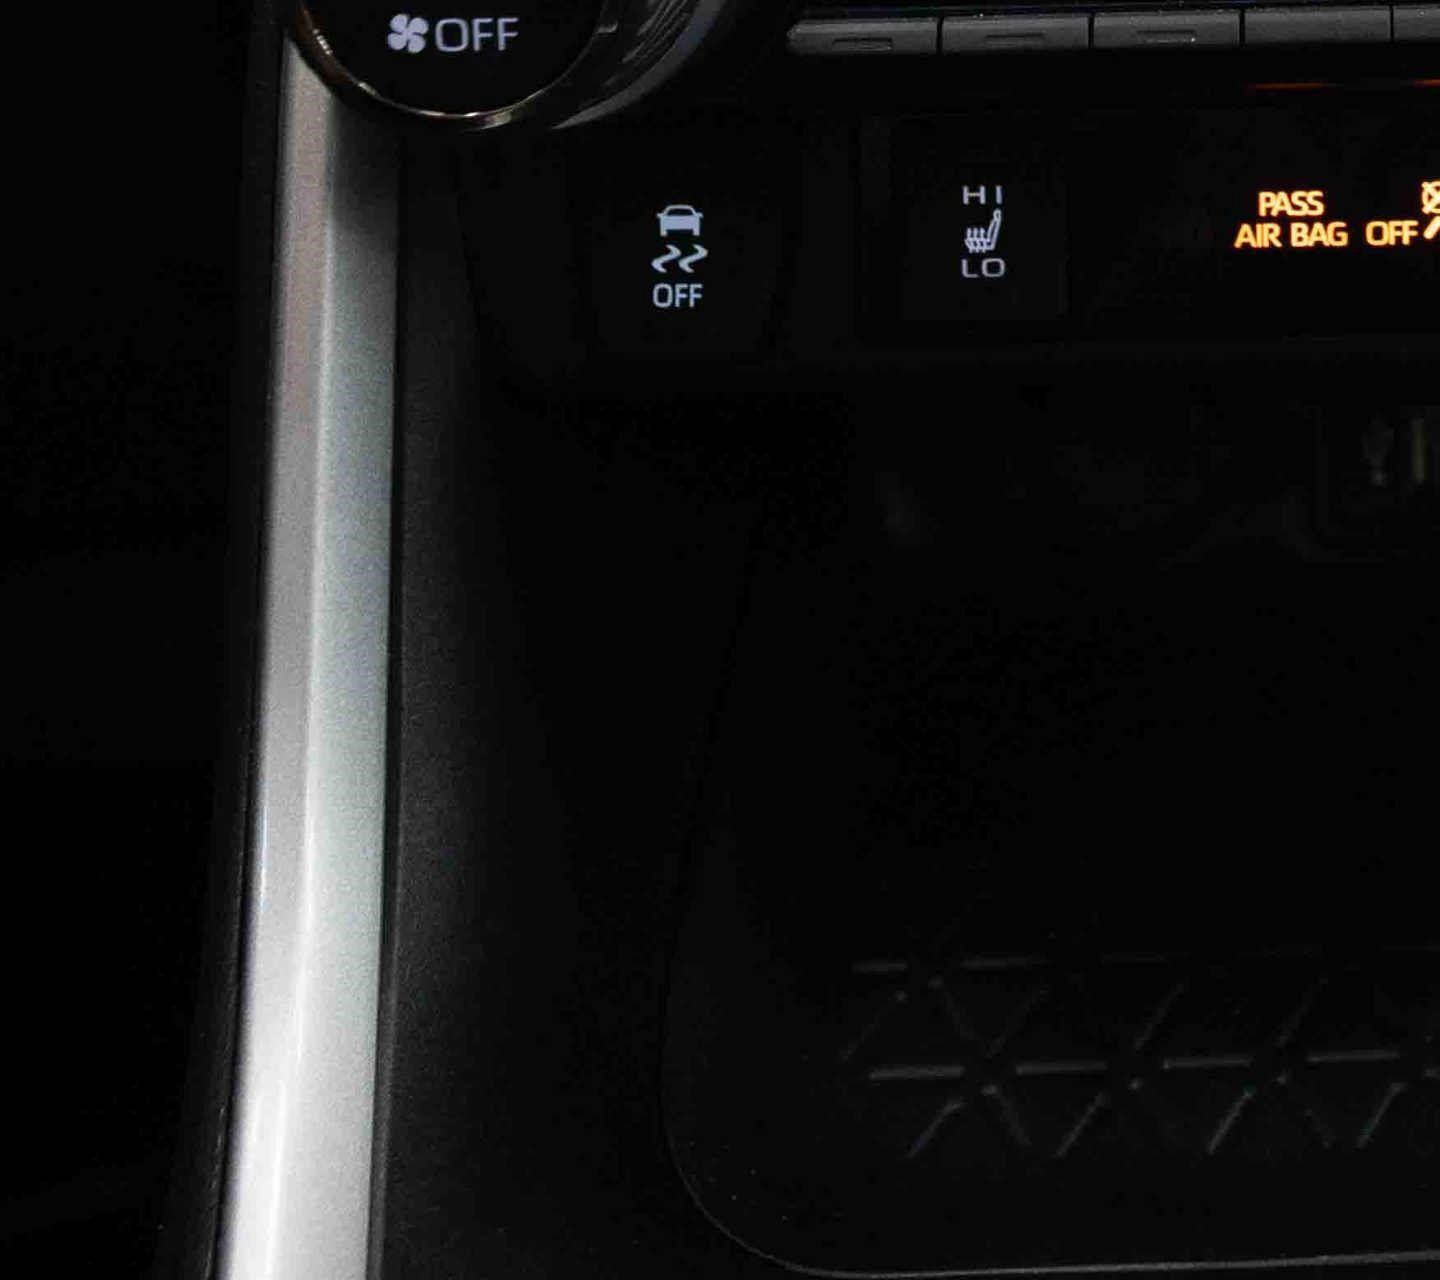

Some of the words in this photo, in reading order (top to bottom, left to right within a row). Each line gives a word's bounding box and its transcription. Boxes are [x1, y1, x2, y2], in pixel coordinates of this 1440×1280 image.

[435, 17, 519, 53] OFF
[962, 184, 1003, 205] HI
[1258, 190, 1325, 217] PASS
[1234, 221, 1282, 248] AIR
[1290, 221, 1348, 248] BAG
[1365, 220, 1419, 246] OFF
[961, 257, 1006, 278] LO
[652, 283, 703, 308] OFF
